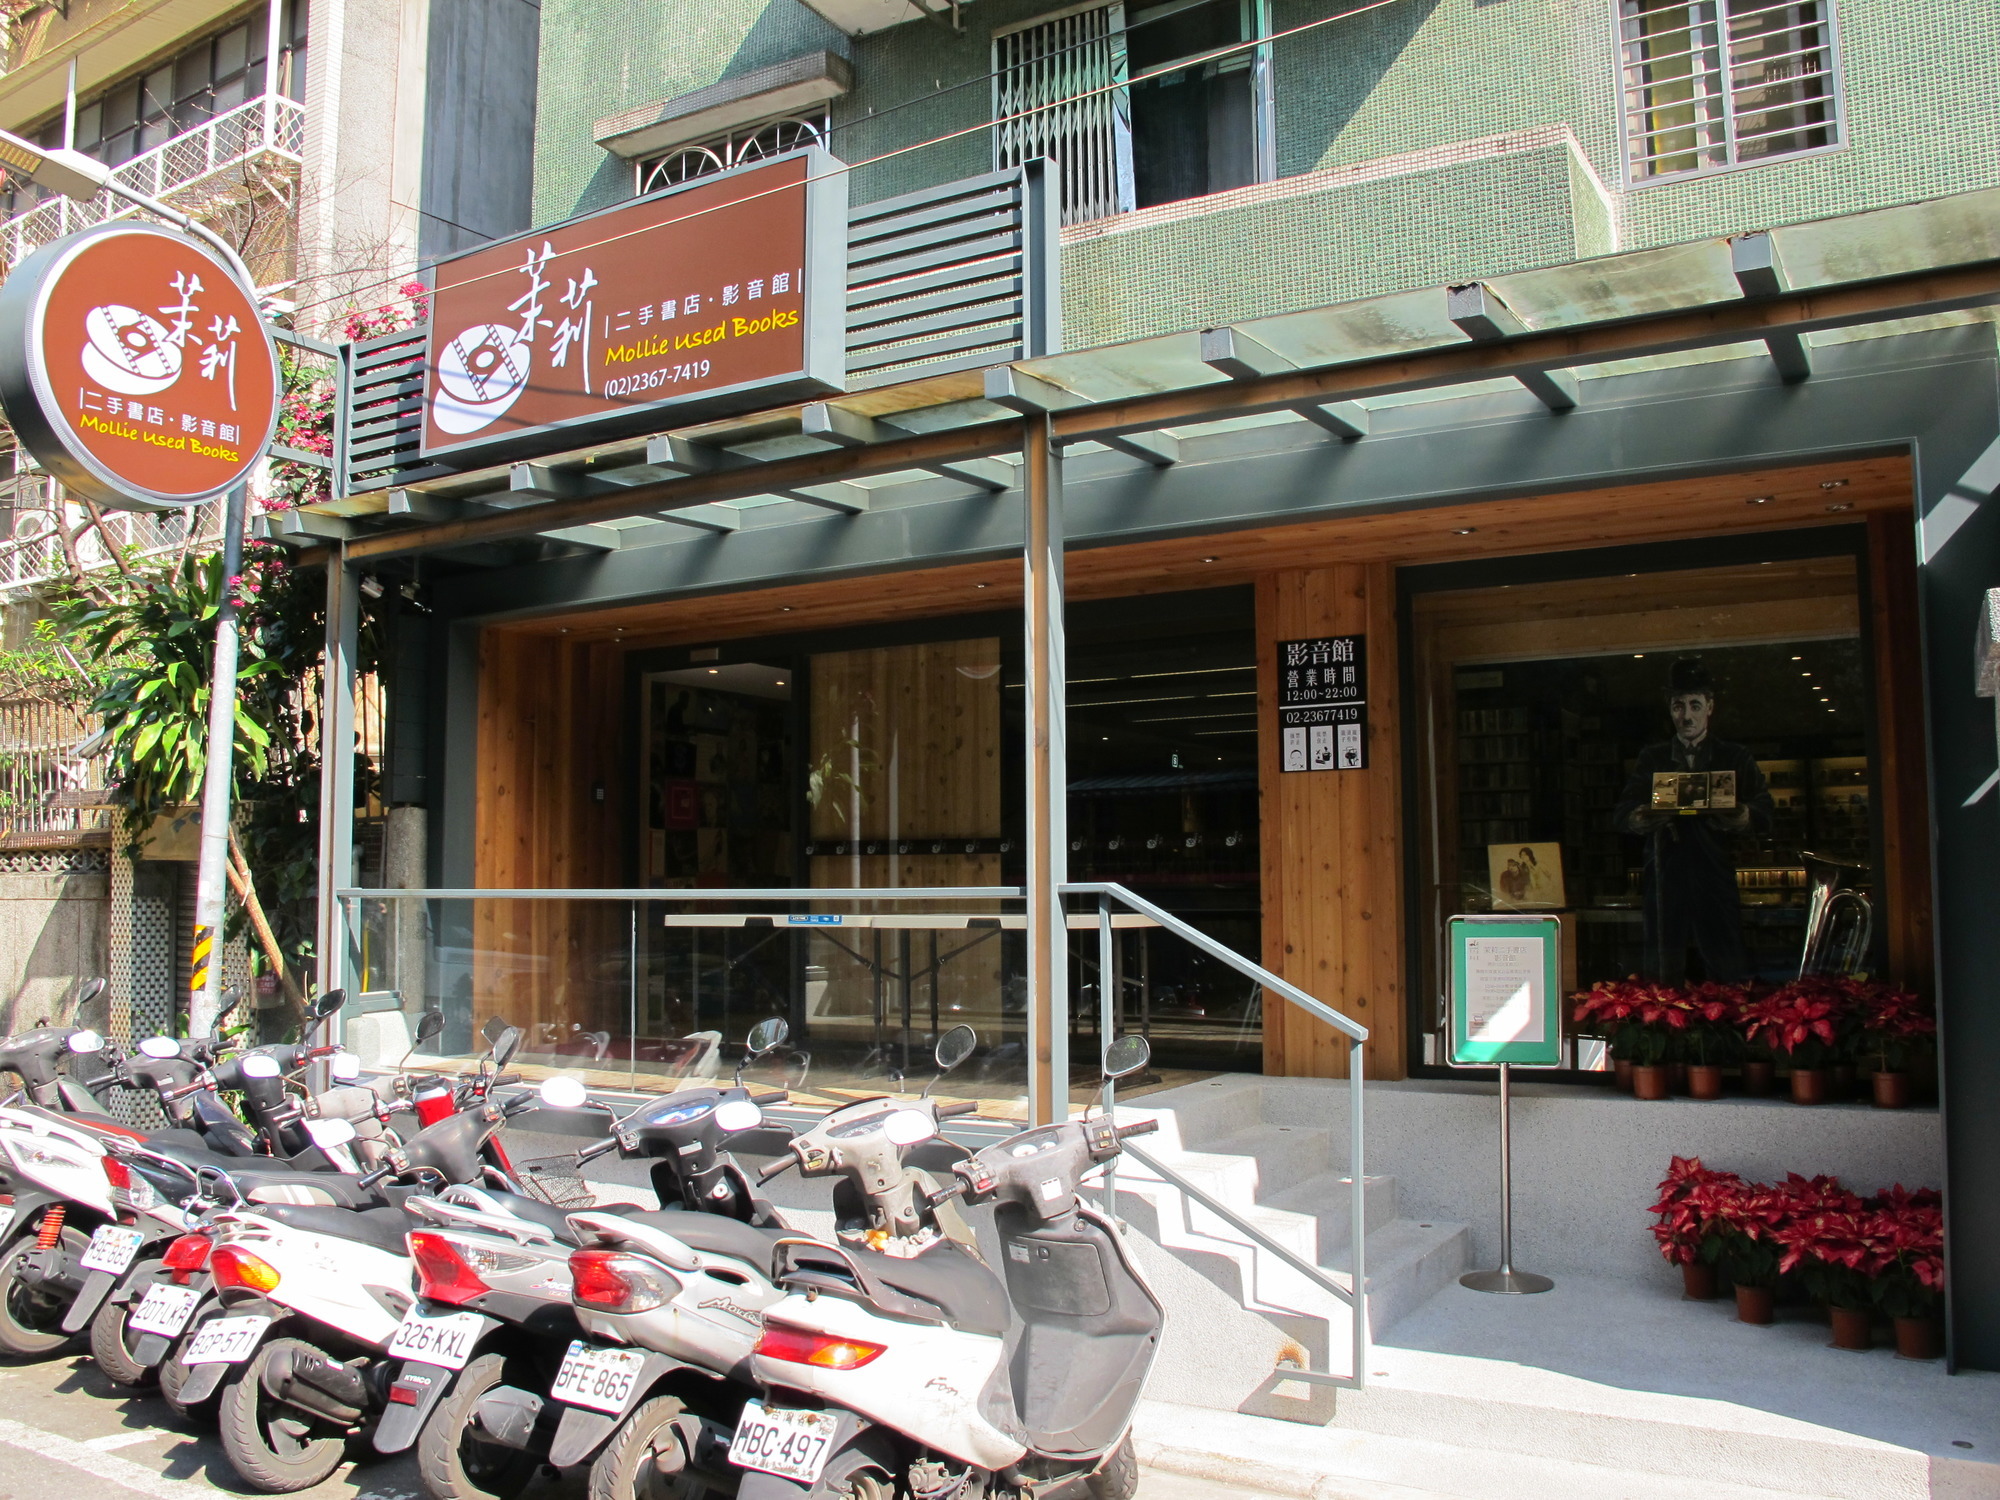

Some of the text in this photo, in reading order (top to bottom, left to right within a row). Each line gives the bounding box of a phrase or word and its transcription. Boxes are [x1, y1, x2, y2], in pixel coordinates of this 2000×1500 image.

[604, 335, 669, 367] Mollie
[734, 308, 800, 339] Books
[604, 359, 711, 400] (02)2367-7419
[80, 414, 138, 440] Mollie
[191, 438, 239, 463] Books
[1287, 639, 1354, 667] 影音館
[1287, 666, 1355, 689] 營業時間
[1286, 708, 1358, 723] 02-23677419
[403, 1374, 433, 1386] KYMCO
